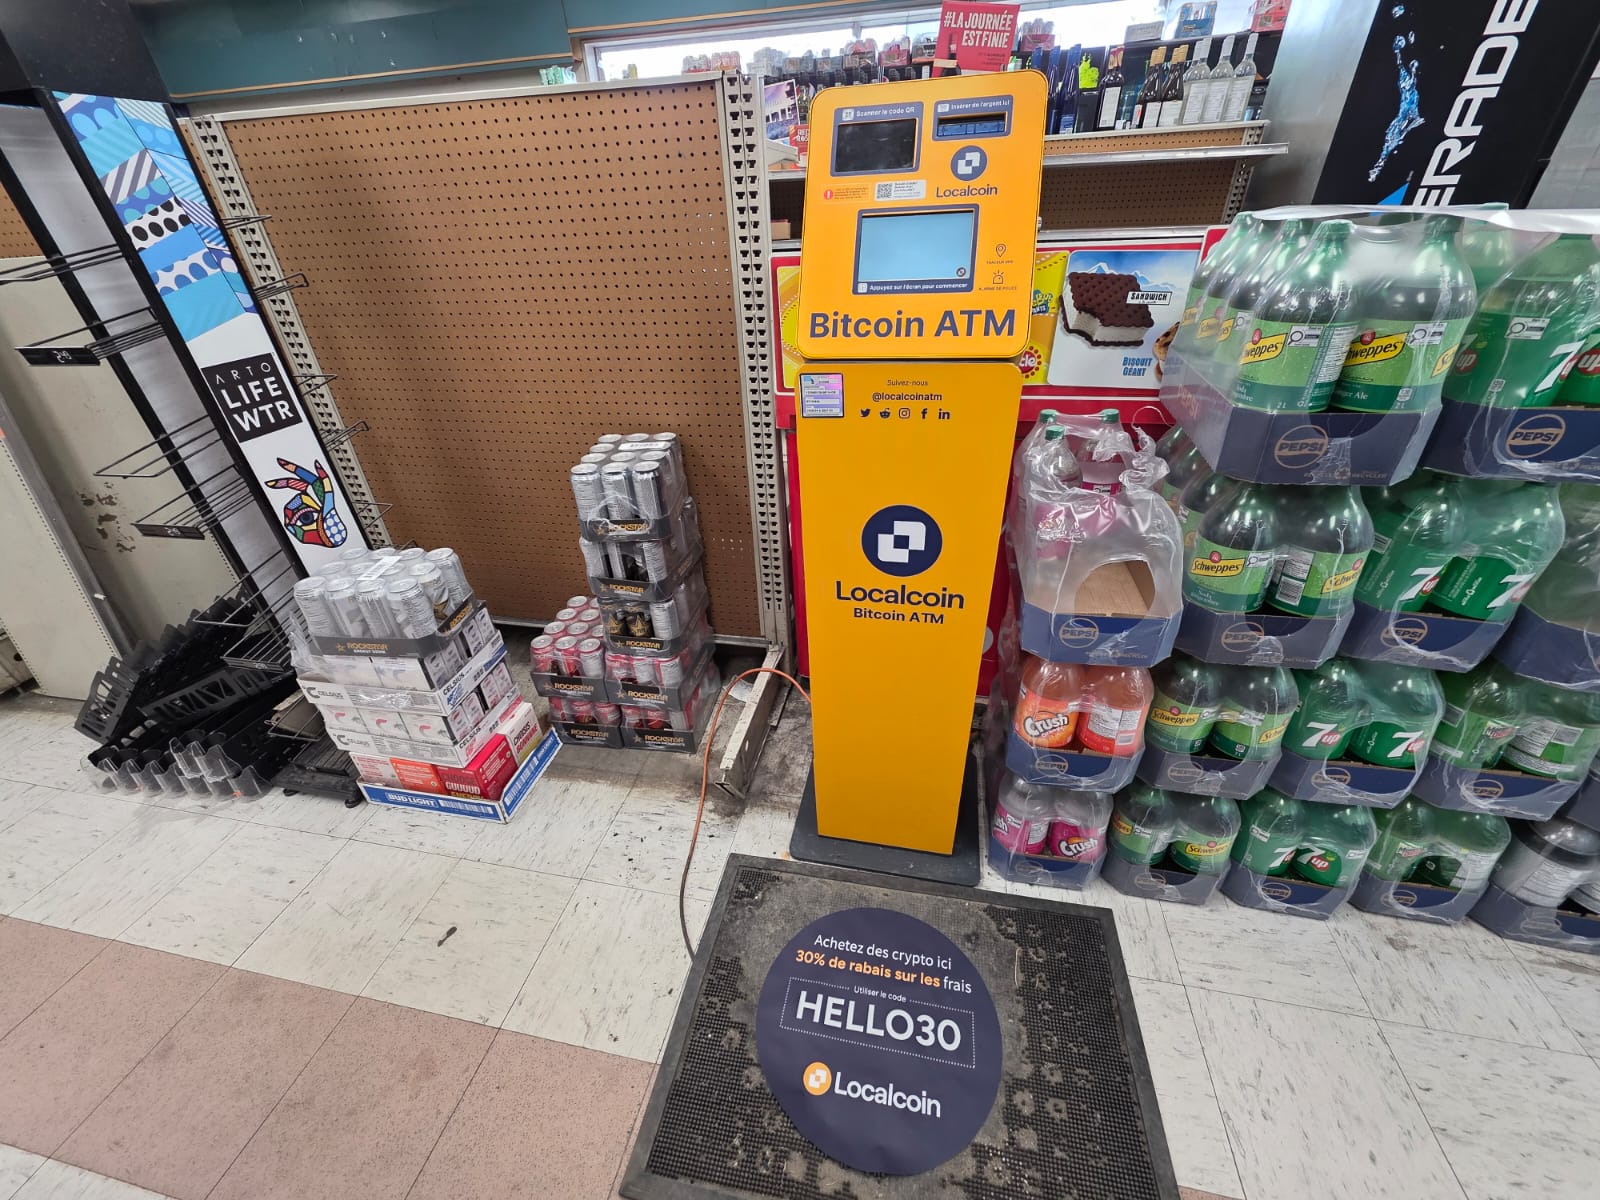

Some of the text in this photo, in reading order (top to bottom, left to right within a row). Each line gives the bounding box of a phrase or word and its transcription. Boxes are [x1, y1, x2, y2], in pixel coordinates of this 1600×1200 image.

[856, 109, 881, 117] Scanner
[888, 107, 904, 115] code
[936, 184, 998, 198] Localcoin
[922, 284, 935, 292] pour
[936, 282, 968, 290] commencer
[1130, 292, 1168, 301] SANDWICH
[810, 309, 1016, 338] Bitcoin ATM
[1122, 356, 1152, 366] BISCUIT
[887, 379, 928, 387] Suivez-nous
[220, 376, 282, 409] LIFE
[872, 392, 942, 402] @localcoinatm
[233, 400, 294, 432] WTR
[1511, 431, 1560, 442] PEPSI
[1279, 440, 1324, 452] PEPSI
[1193, 561, 1241, 574] Schweppes
[836, 580, 965, 609] Localcoin
[853, 608, 944, 624] Bitcoin ATM
[1062, 629, 1097, 638] PEPSI
[626, 640, 661, 650] ROCKSTAR
[443, 672, 465, 695] CELSIUS
[554, 682, 594, 692] ROCKSTAR
[628, 691, 668, 701] ROCKSTAR
[1152, 710, 1195, 724] Schweppes
[1025, 714, 1069, 736] Crush
[460, 727, 481, 749] CELSIUS
[570, 729, 609, 738] ROCKSTAR
[645, 735, 684, 743] ROCKSTAR
[388, 794, 436, 806] BUD LIGHT
[1060, 838, 1098, 857] Crush
[814, 934, 952, 970] Achetez des crypto ici
[795, 949, 972, 994] 30% de rabais sur les frais
[854, 985, 908, 1003] Utiliser le code
[796, 990, 962, 1052] HELLO30
[834, 1071, 942, 1118] Localcoin
